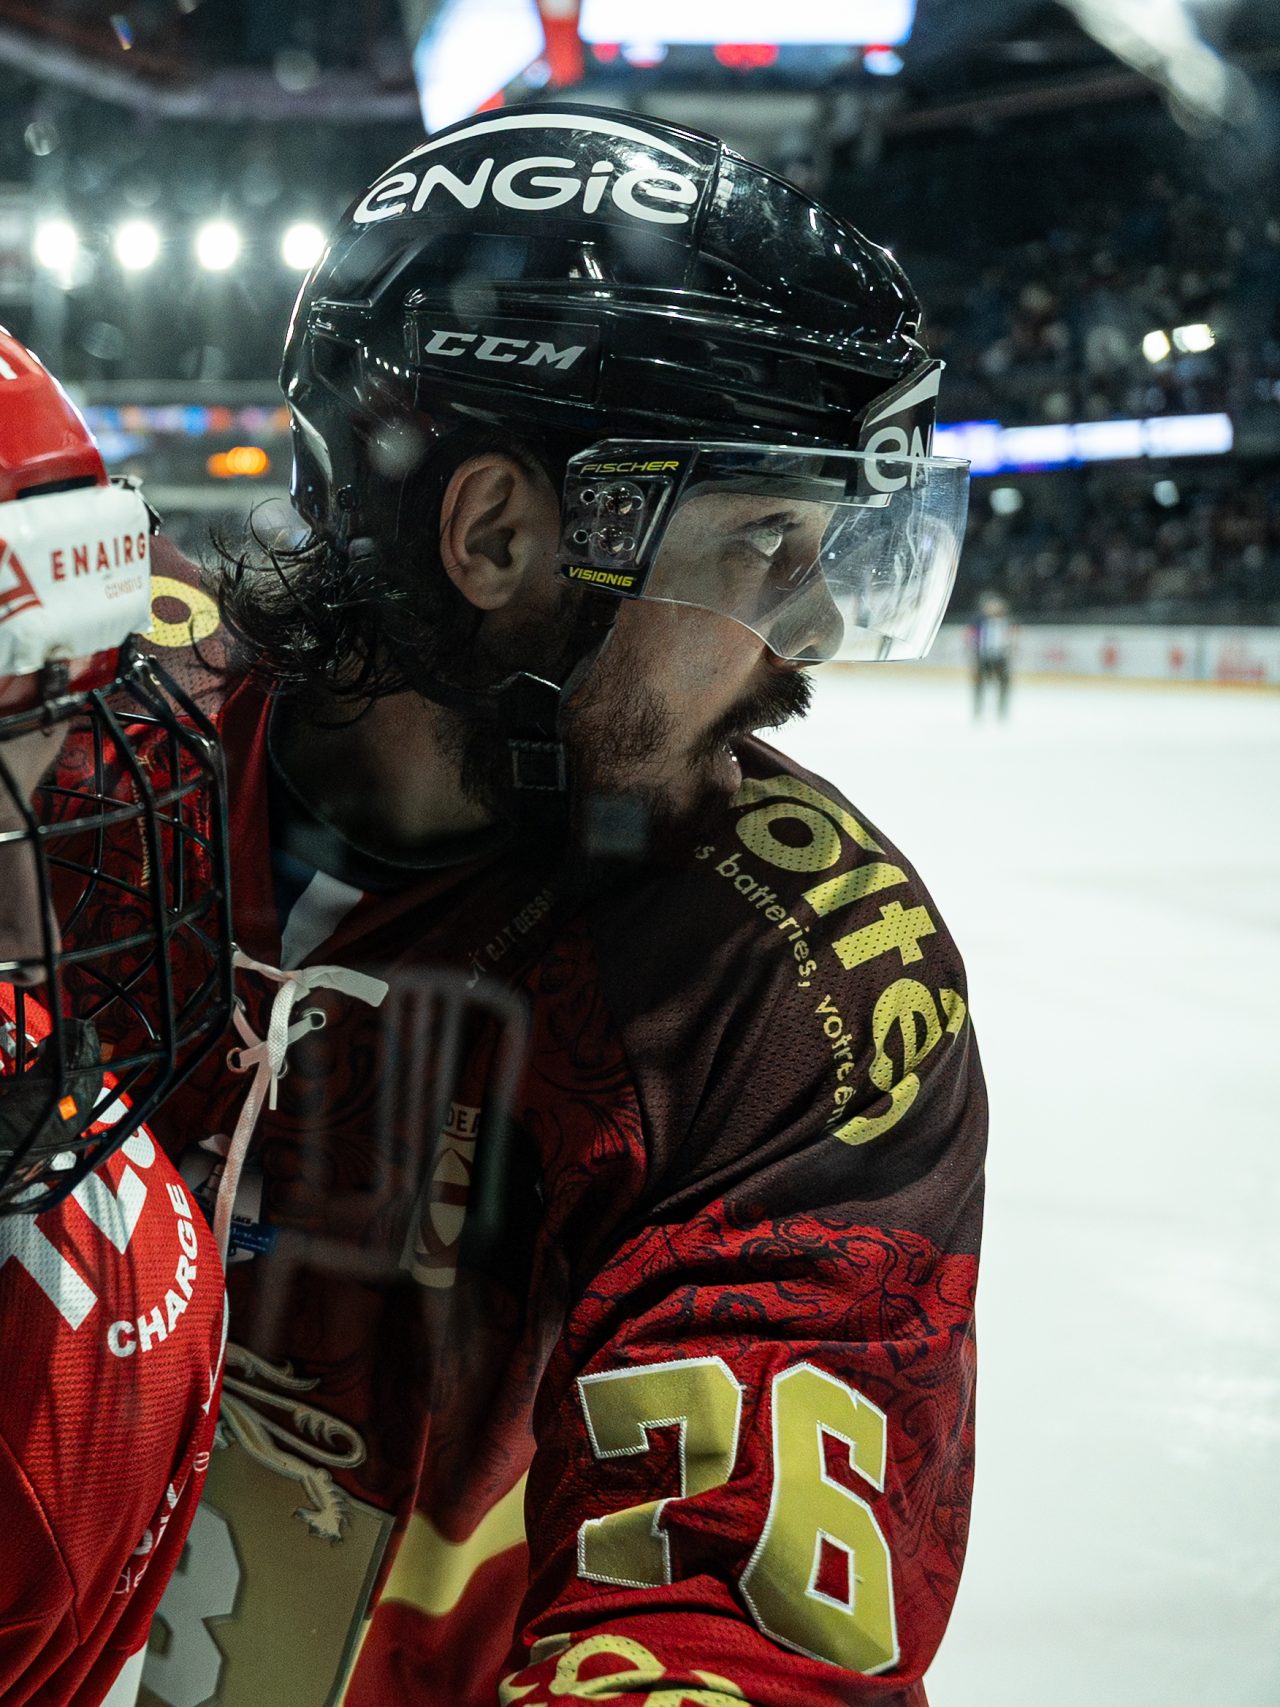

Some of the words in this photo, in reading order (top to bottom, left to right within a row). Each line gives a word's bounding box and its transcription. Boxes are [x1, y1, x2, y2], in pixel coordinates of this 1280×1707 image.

[424, 330, 586, 371] CCM
[580, 461, 679, 474] FISCHER
[715, 853, 818, 988] batteries,
[815, 993, 856, 1079] votre
[107, 1182, 197, 1359] CHARGE
[576, 1355, 901, 1677] 26
